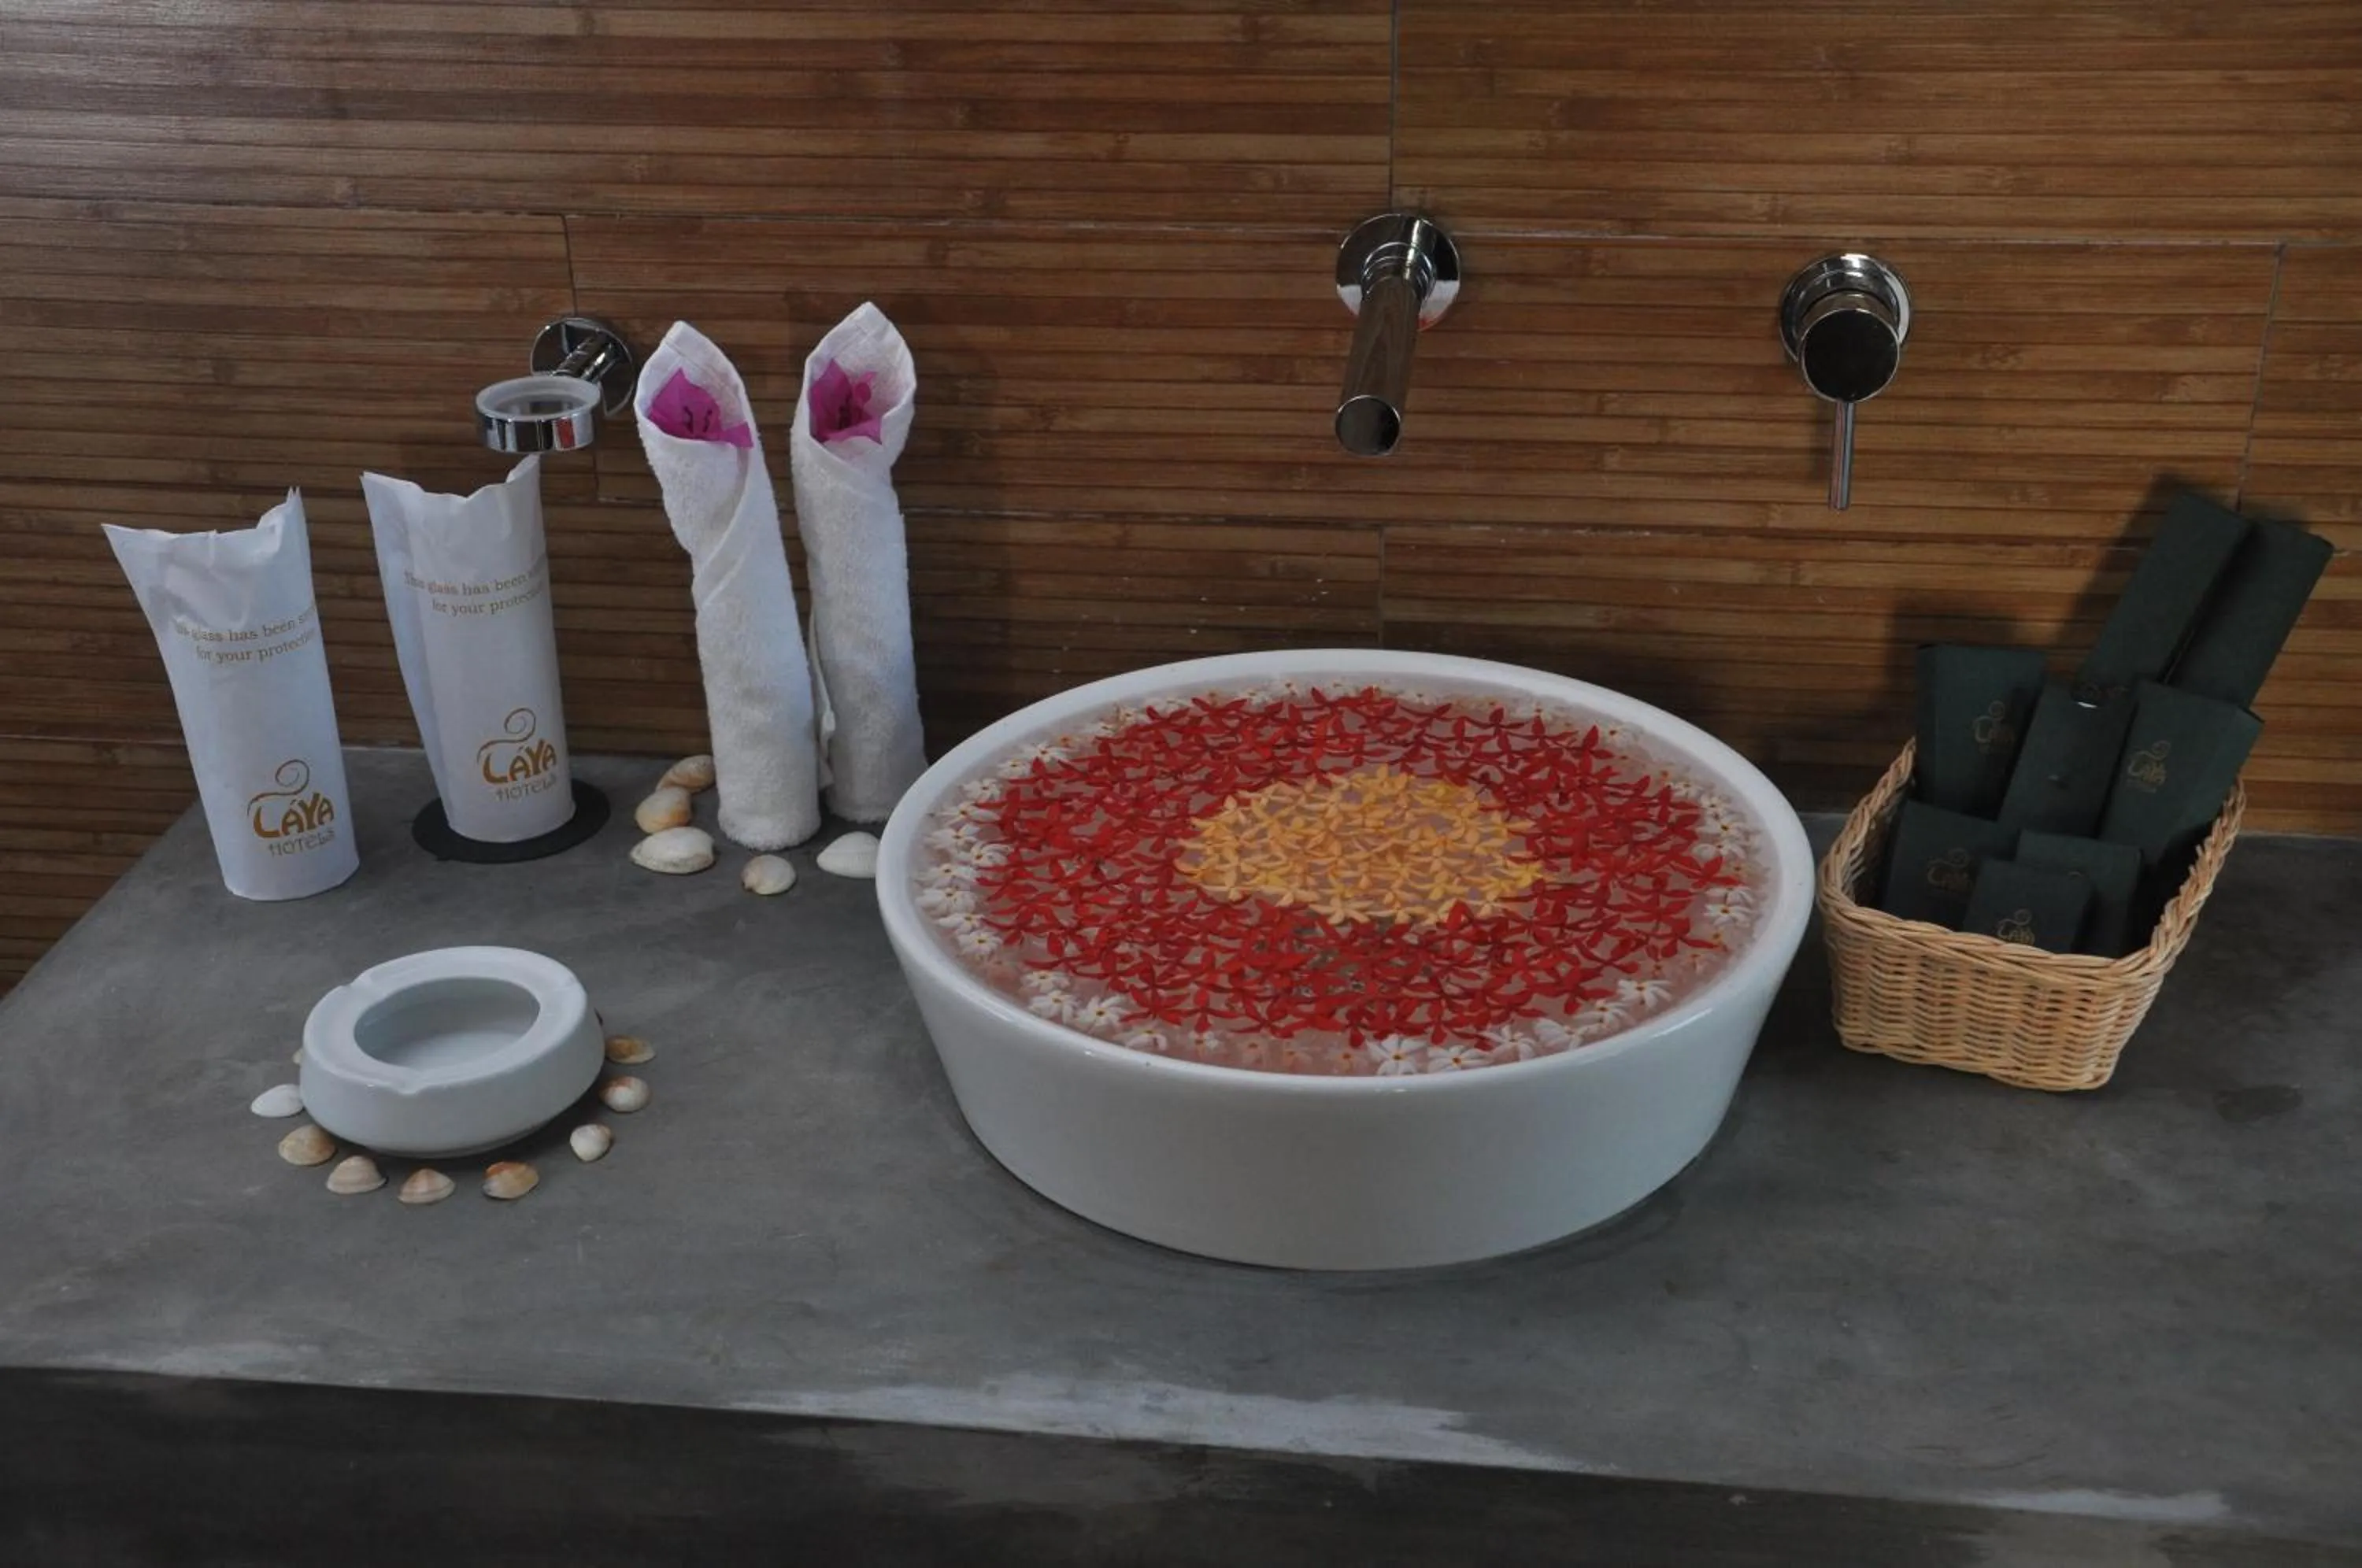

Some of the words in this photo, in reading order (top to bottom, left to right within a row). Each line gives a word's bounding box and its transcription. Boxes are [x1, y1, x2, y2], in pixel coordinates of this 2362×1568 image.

[461, 582, 490, 597] has
[495, 573, 528, 591] been
[450, 602, 486, 616] your
[228, 629, 258, 642] has
[263, 619, 294, 637] been
[216, 649, 252, 664] your
[268, 829, 335, 856] HOTELS
